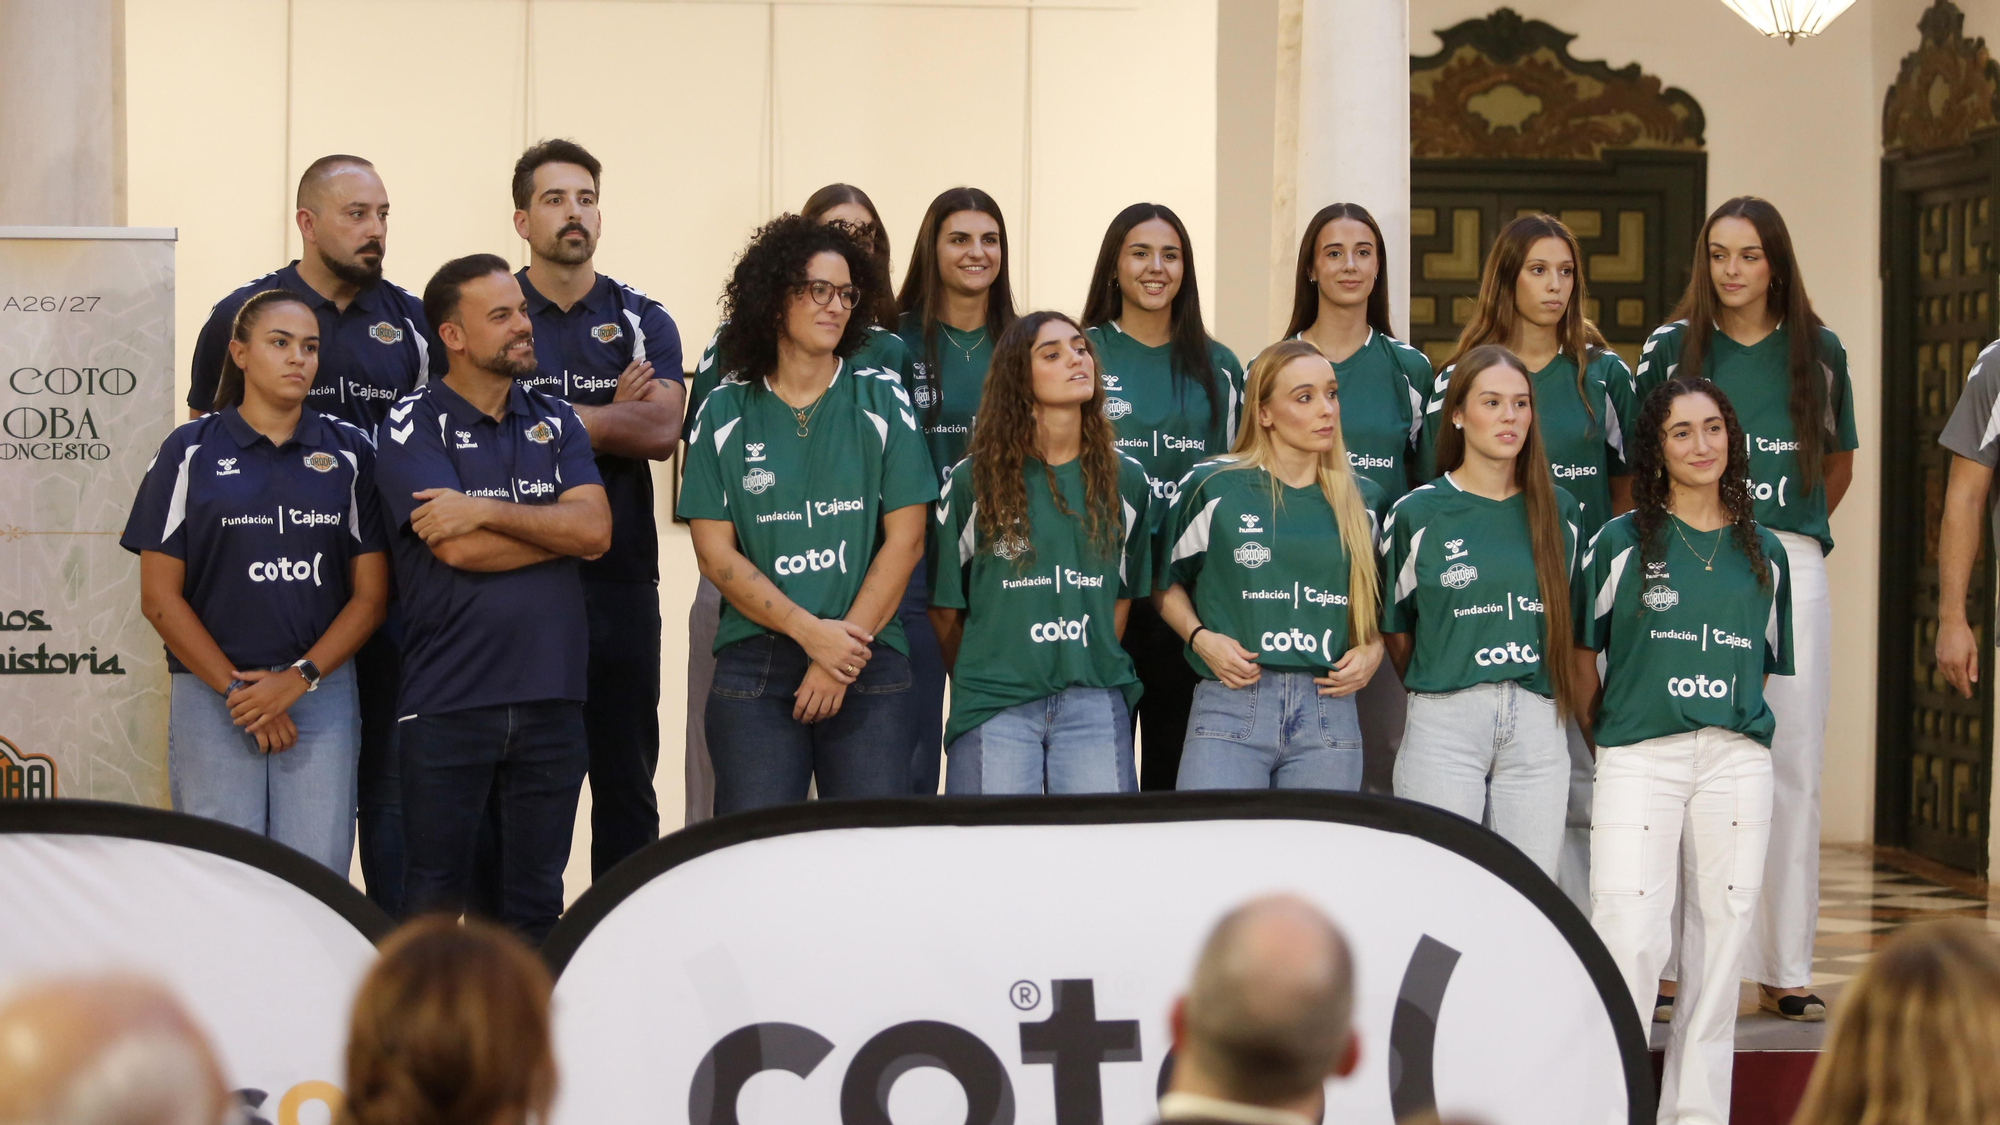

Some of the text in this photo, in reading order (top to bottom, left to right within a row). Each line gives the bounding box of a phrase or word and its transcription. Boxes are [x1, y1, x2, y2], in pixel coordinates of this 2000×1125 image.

[10, 367, 136, 395] COTO
[573, 375, 618, 392] Cajaso
[308, 381, 398, 401] ación Cajasol
[921, 424, 968, 434] ndación
[1111, 438, 1149, 448] ndación
[1755, 437, 1799, 455] Cajaso
[1346, 451, 1394, 469] Cajasol
[1551, 463, 1598, 481] Cajaso
[518, 478, 555, 497] Cajas
[222, 509, 340, 528] Fundación Cajasol
[757, 497, 863, 523] Fundación Cajasol
[1003, 575, 1051, 588] Fundación
[1242, 586, 1348, 606] Fundación Cajaso
[1454, 596, 1544, 618] Fundación Caja
[1651, 629, 1752, 650] Fundación Cajas
[1475, 641, 1539, 667] coto
